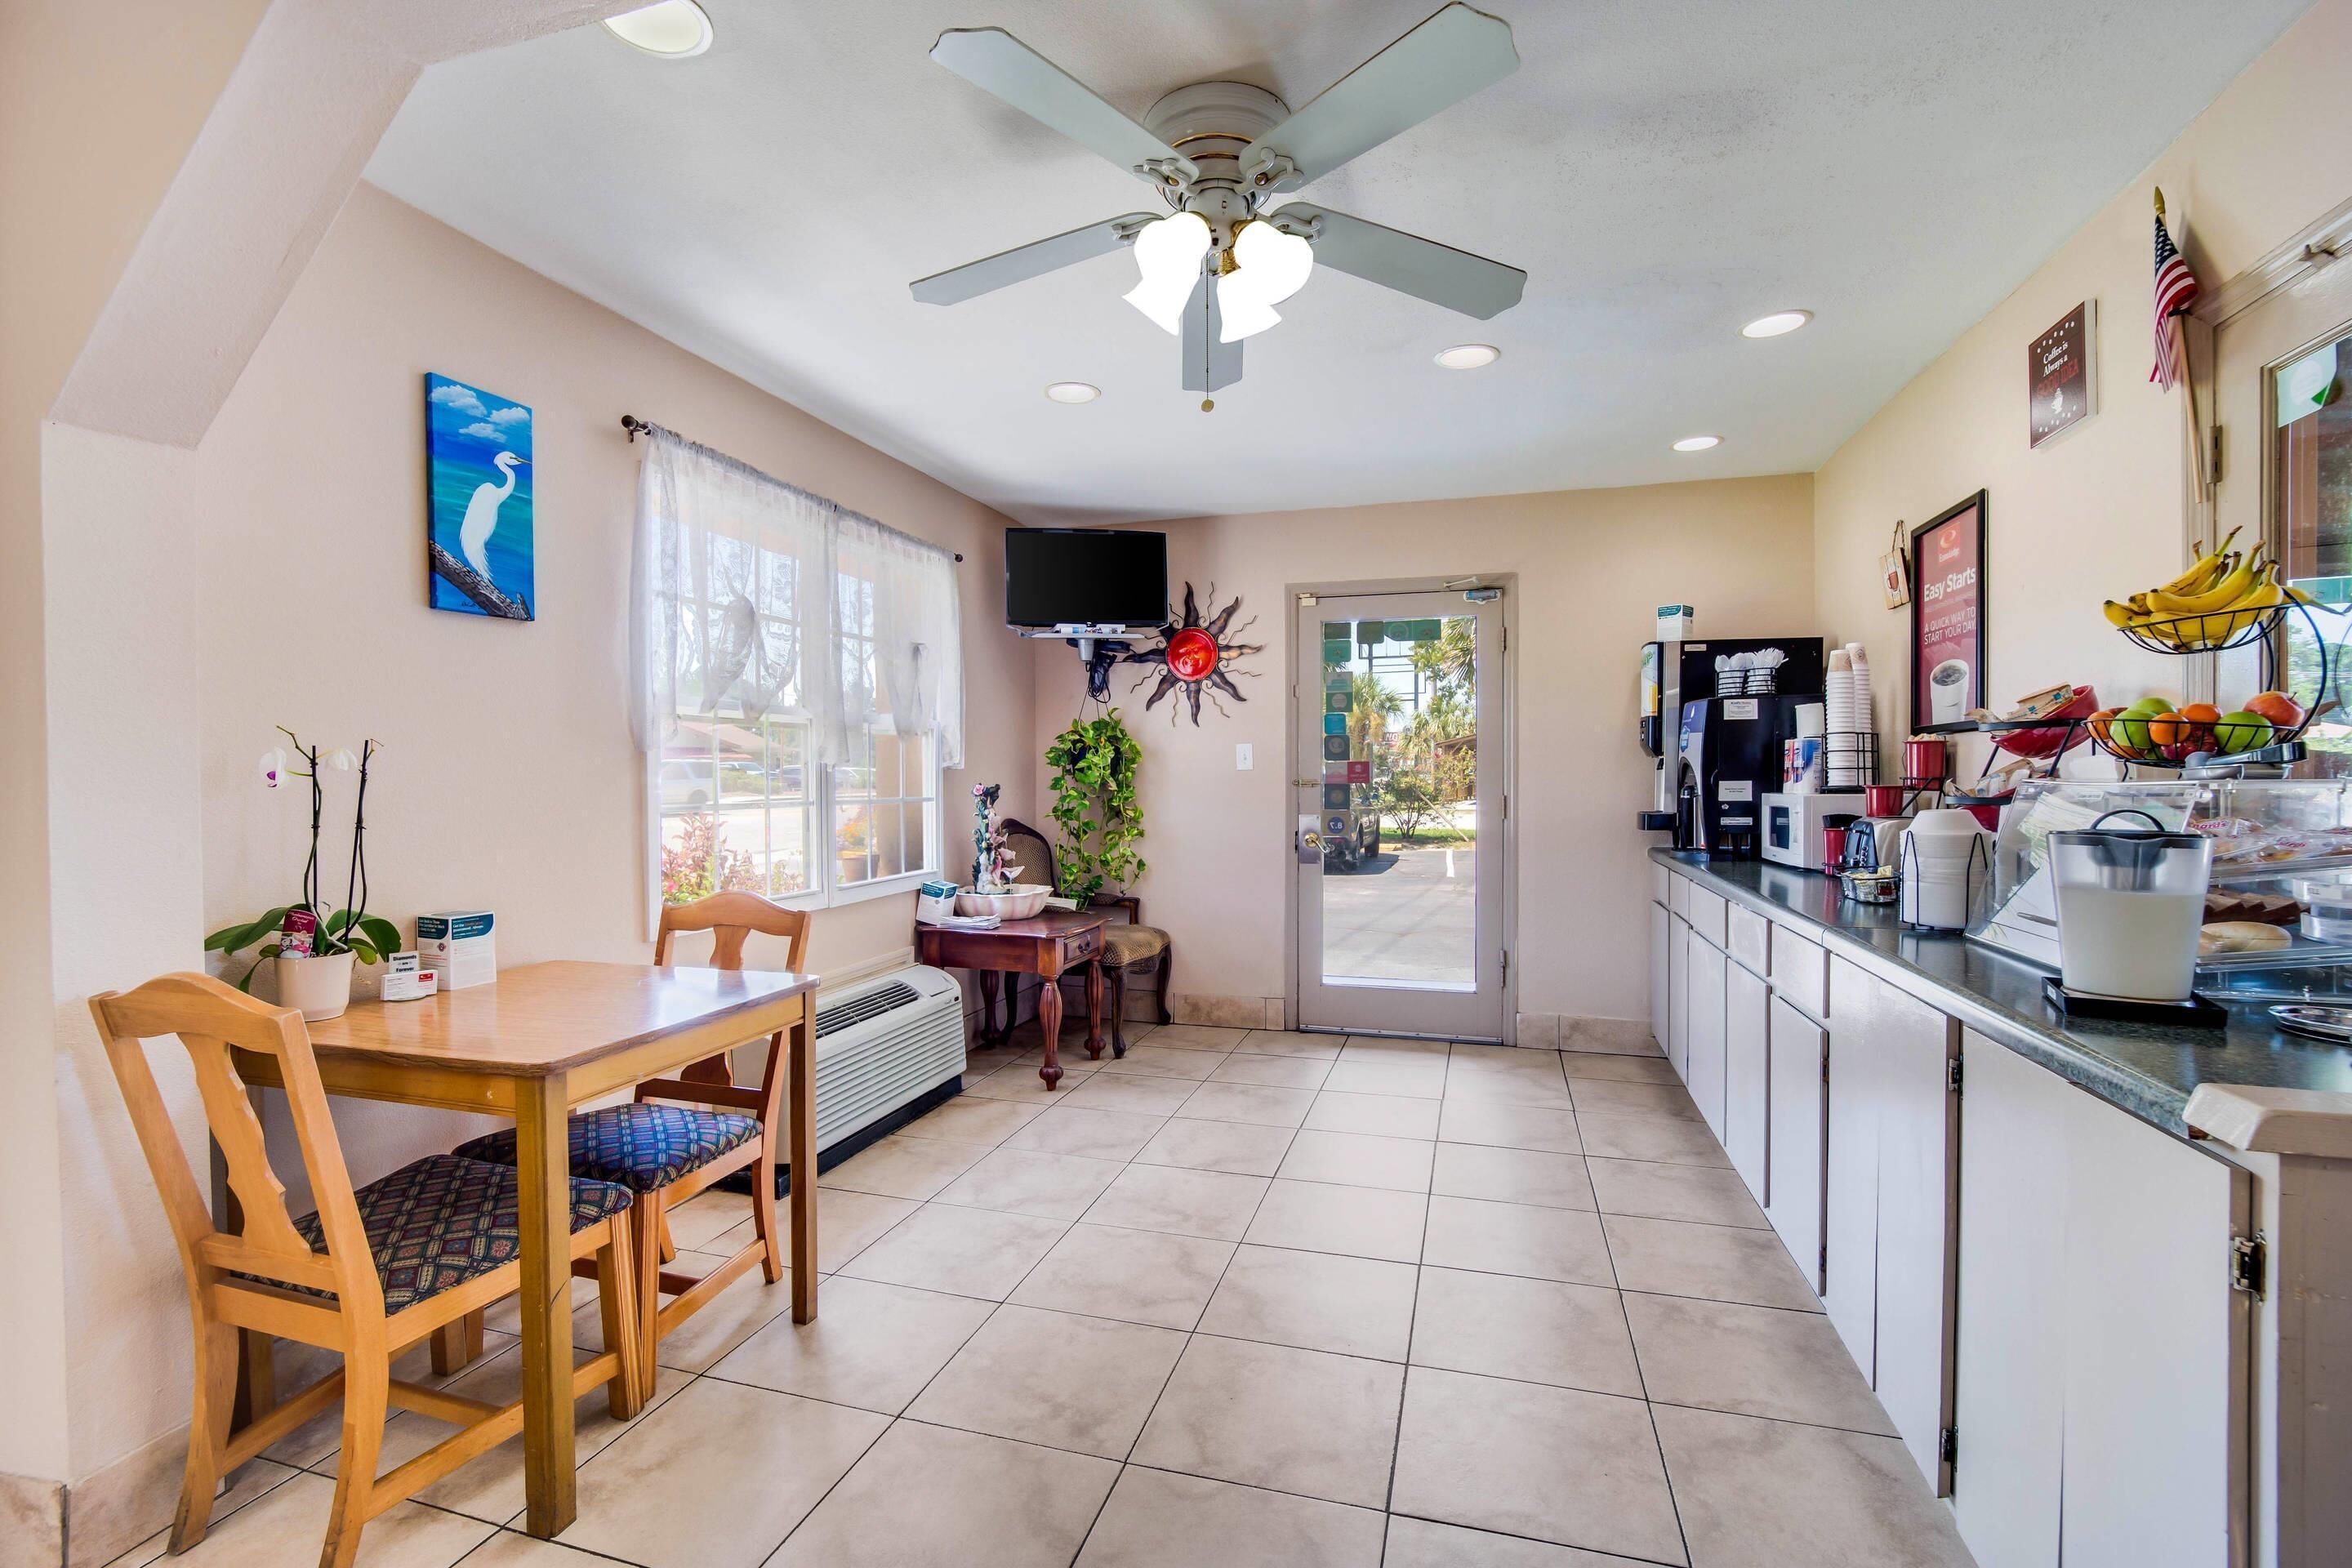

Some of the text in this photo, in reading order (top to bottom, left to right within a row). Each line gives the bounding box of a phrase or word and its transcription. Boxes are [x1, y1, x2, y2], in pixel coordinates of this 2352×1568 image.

[2043, 341, 2069, 364] Coffee is
[2043, 358, 2064, 377] Always
[1924, 581, 1945, 602] Easy
[1946, 567, 1976, 593] Starts
[1924, 606, 1976, 633] A QUICK WAY TO
[1924, 629, 1944, 645] START
[1944, 624, 1962, 639] YOUR
